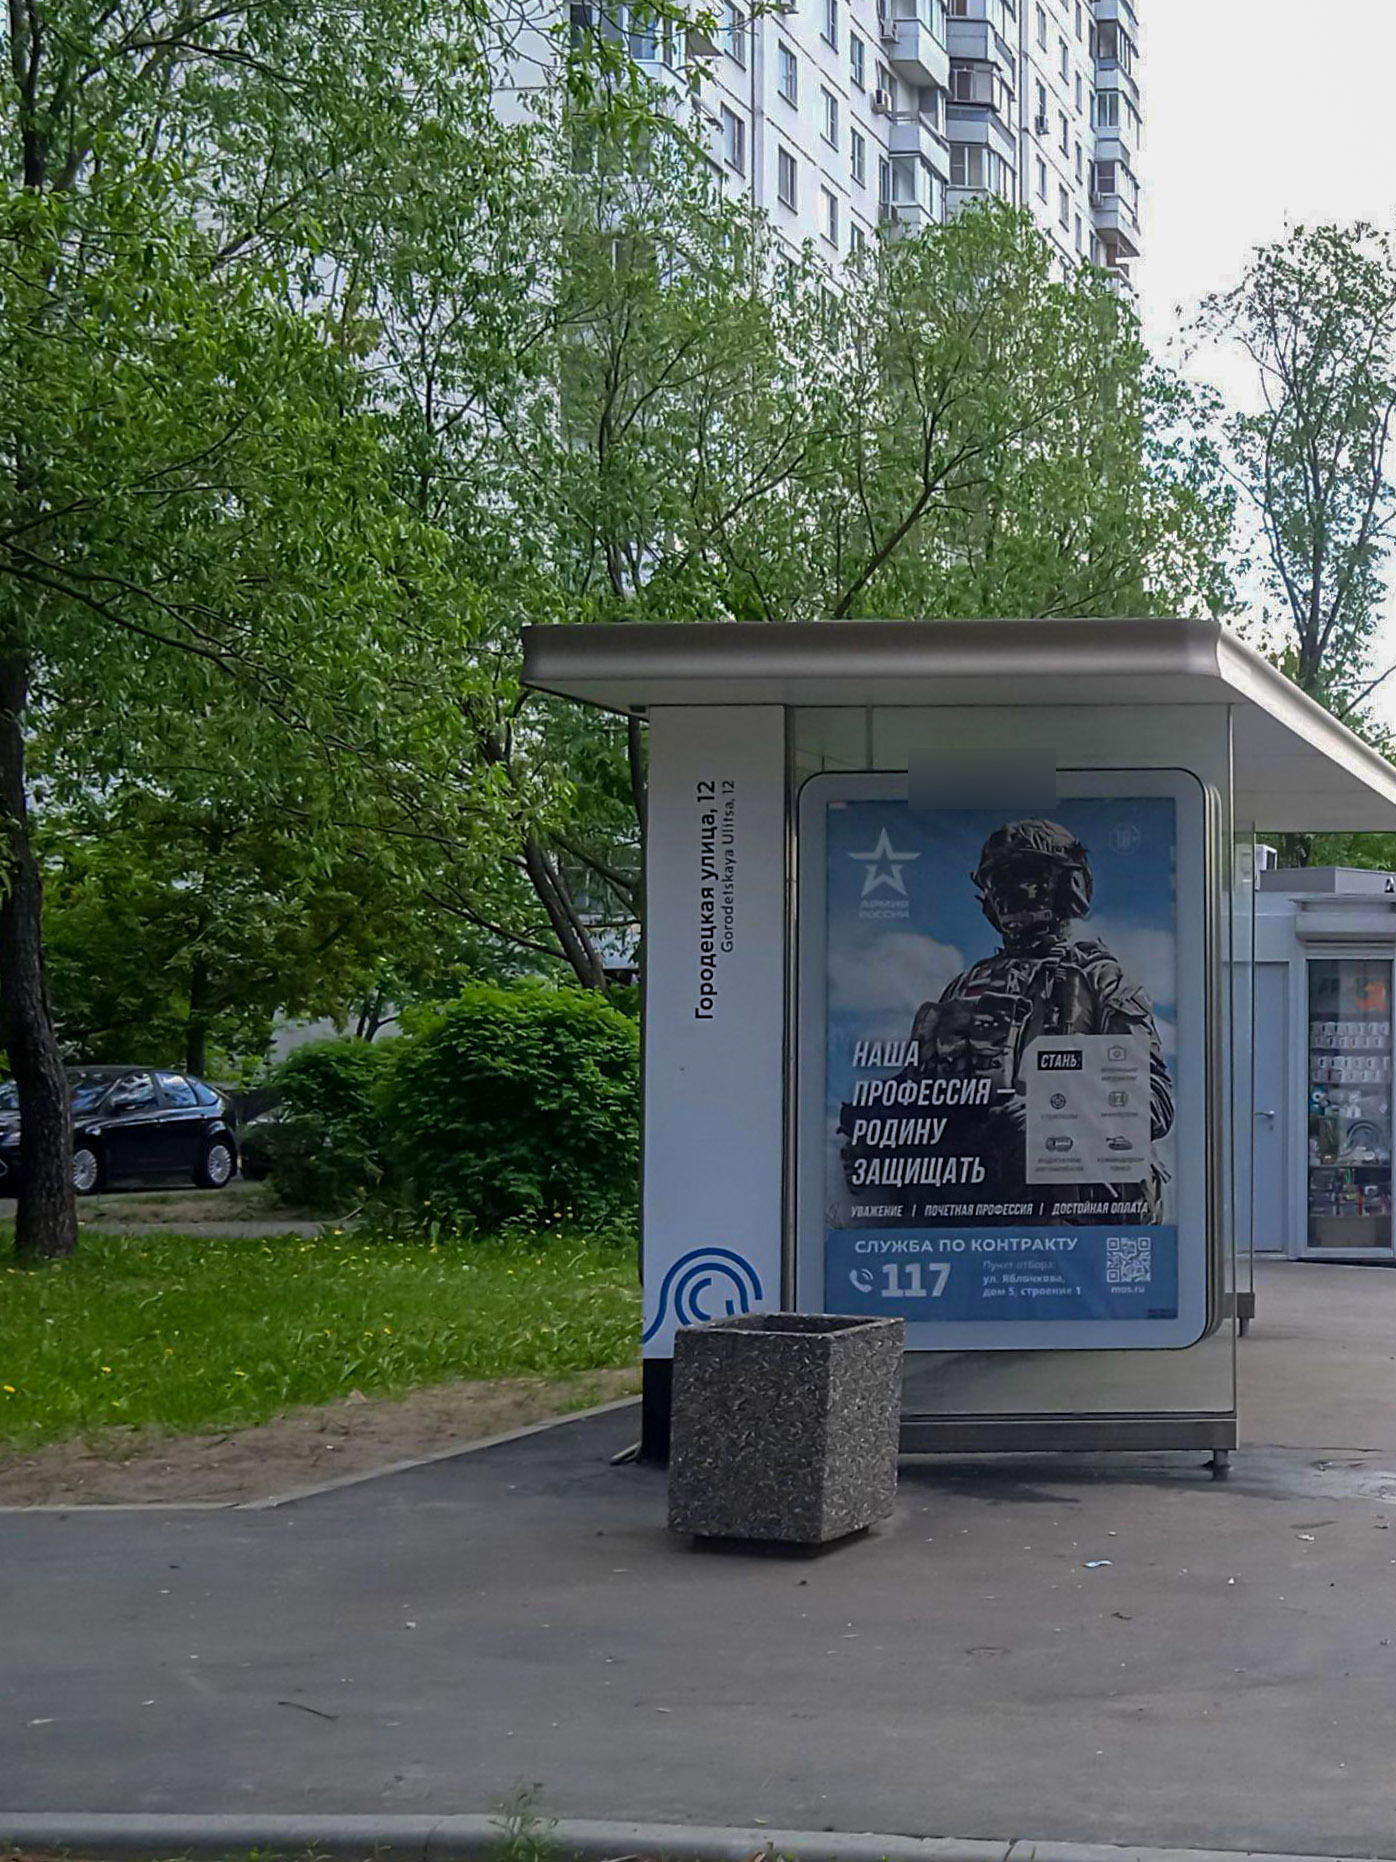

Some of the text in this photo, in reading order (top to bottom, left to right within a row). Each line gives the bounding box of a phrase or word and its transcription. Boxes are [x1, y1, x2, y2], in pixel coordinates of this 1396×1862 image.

[721, 780, 737, 953] Gorodetskaya Ulitsa, 12
[695, 780, 719, 1020] Городецкая улица, 12
[852, 1041, 920, 1067] НАША
[852, 1078, 992, 1106] ПРОФЕССИЯ
[852, 1117, 948, 1148] РОДИНУ
[852, 1156, 986, 1187] ЗАЩИЩАТЬ
[851, 1204, 903, 1217] УВАЖЕНИЕ
[924, 1202, 1034, 1217] ПОЧЕТНАЯ ПРОФЕССИЯ
[1051, 1200, 1148, 1215] ДОСТОЙНАЯ ОПЛАТА
[855, 1237, 1078, 1253] СЛУЖБА ПО КОНТРАКТУ
[881, 1262, 951, 1297] 117
[983, 1288, 1006, 1297] дом
[1020, 1287, 1073, 1298] строение
